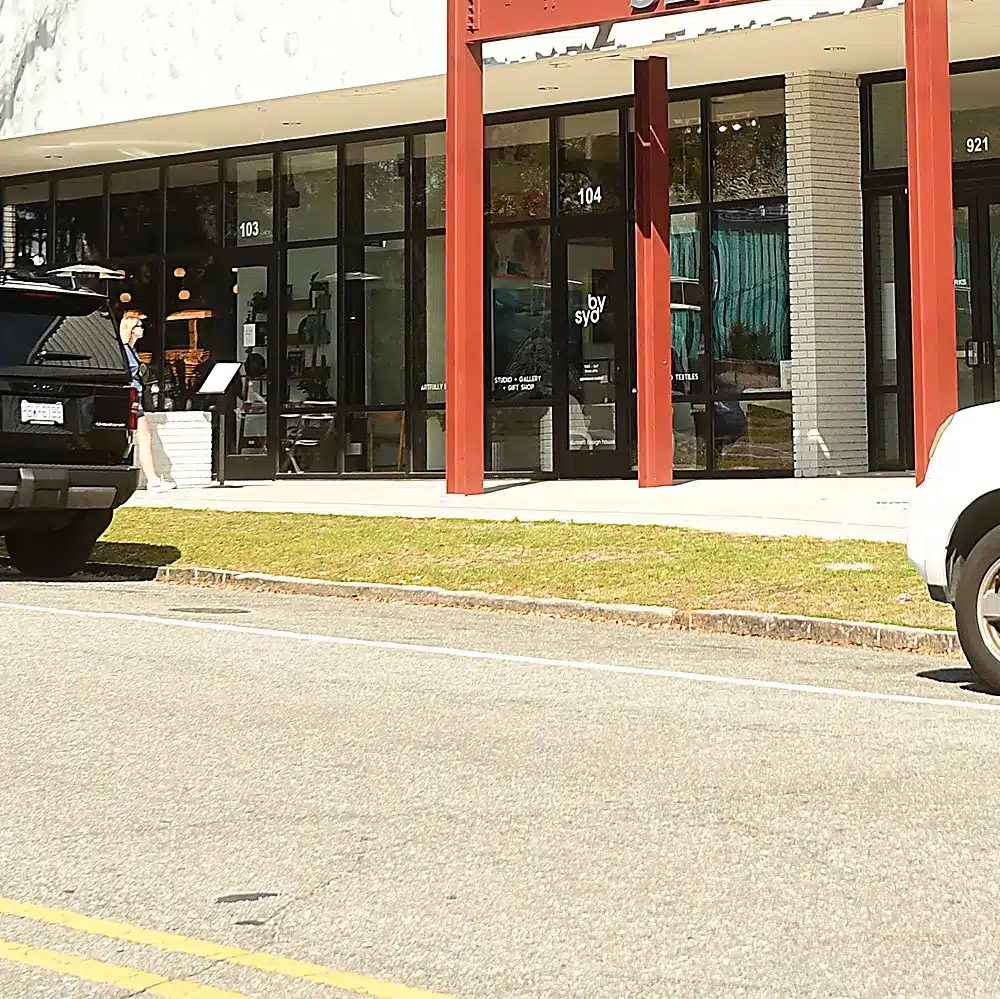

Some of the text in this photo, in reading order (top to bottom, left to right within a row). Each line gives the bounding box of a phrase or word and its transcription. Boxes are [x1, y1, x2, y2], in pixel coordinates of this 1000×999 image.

[966, 137, 989, 152] 921
[577, 186, 602, 204] 104
[240, 221, 259, 237] 103
[588, 294, 606, 313] by
[575, 307, 600, 327] syd
[494, 376, 512, 384] STUDIO
[519, 375, 541, 383] GALLERY
[675, 373, 698, 381] TEXTILES
